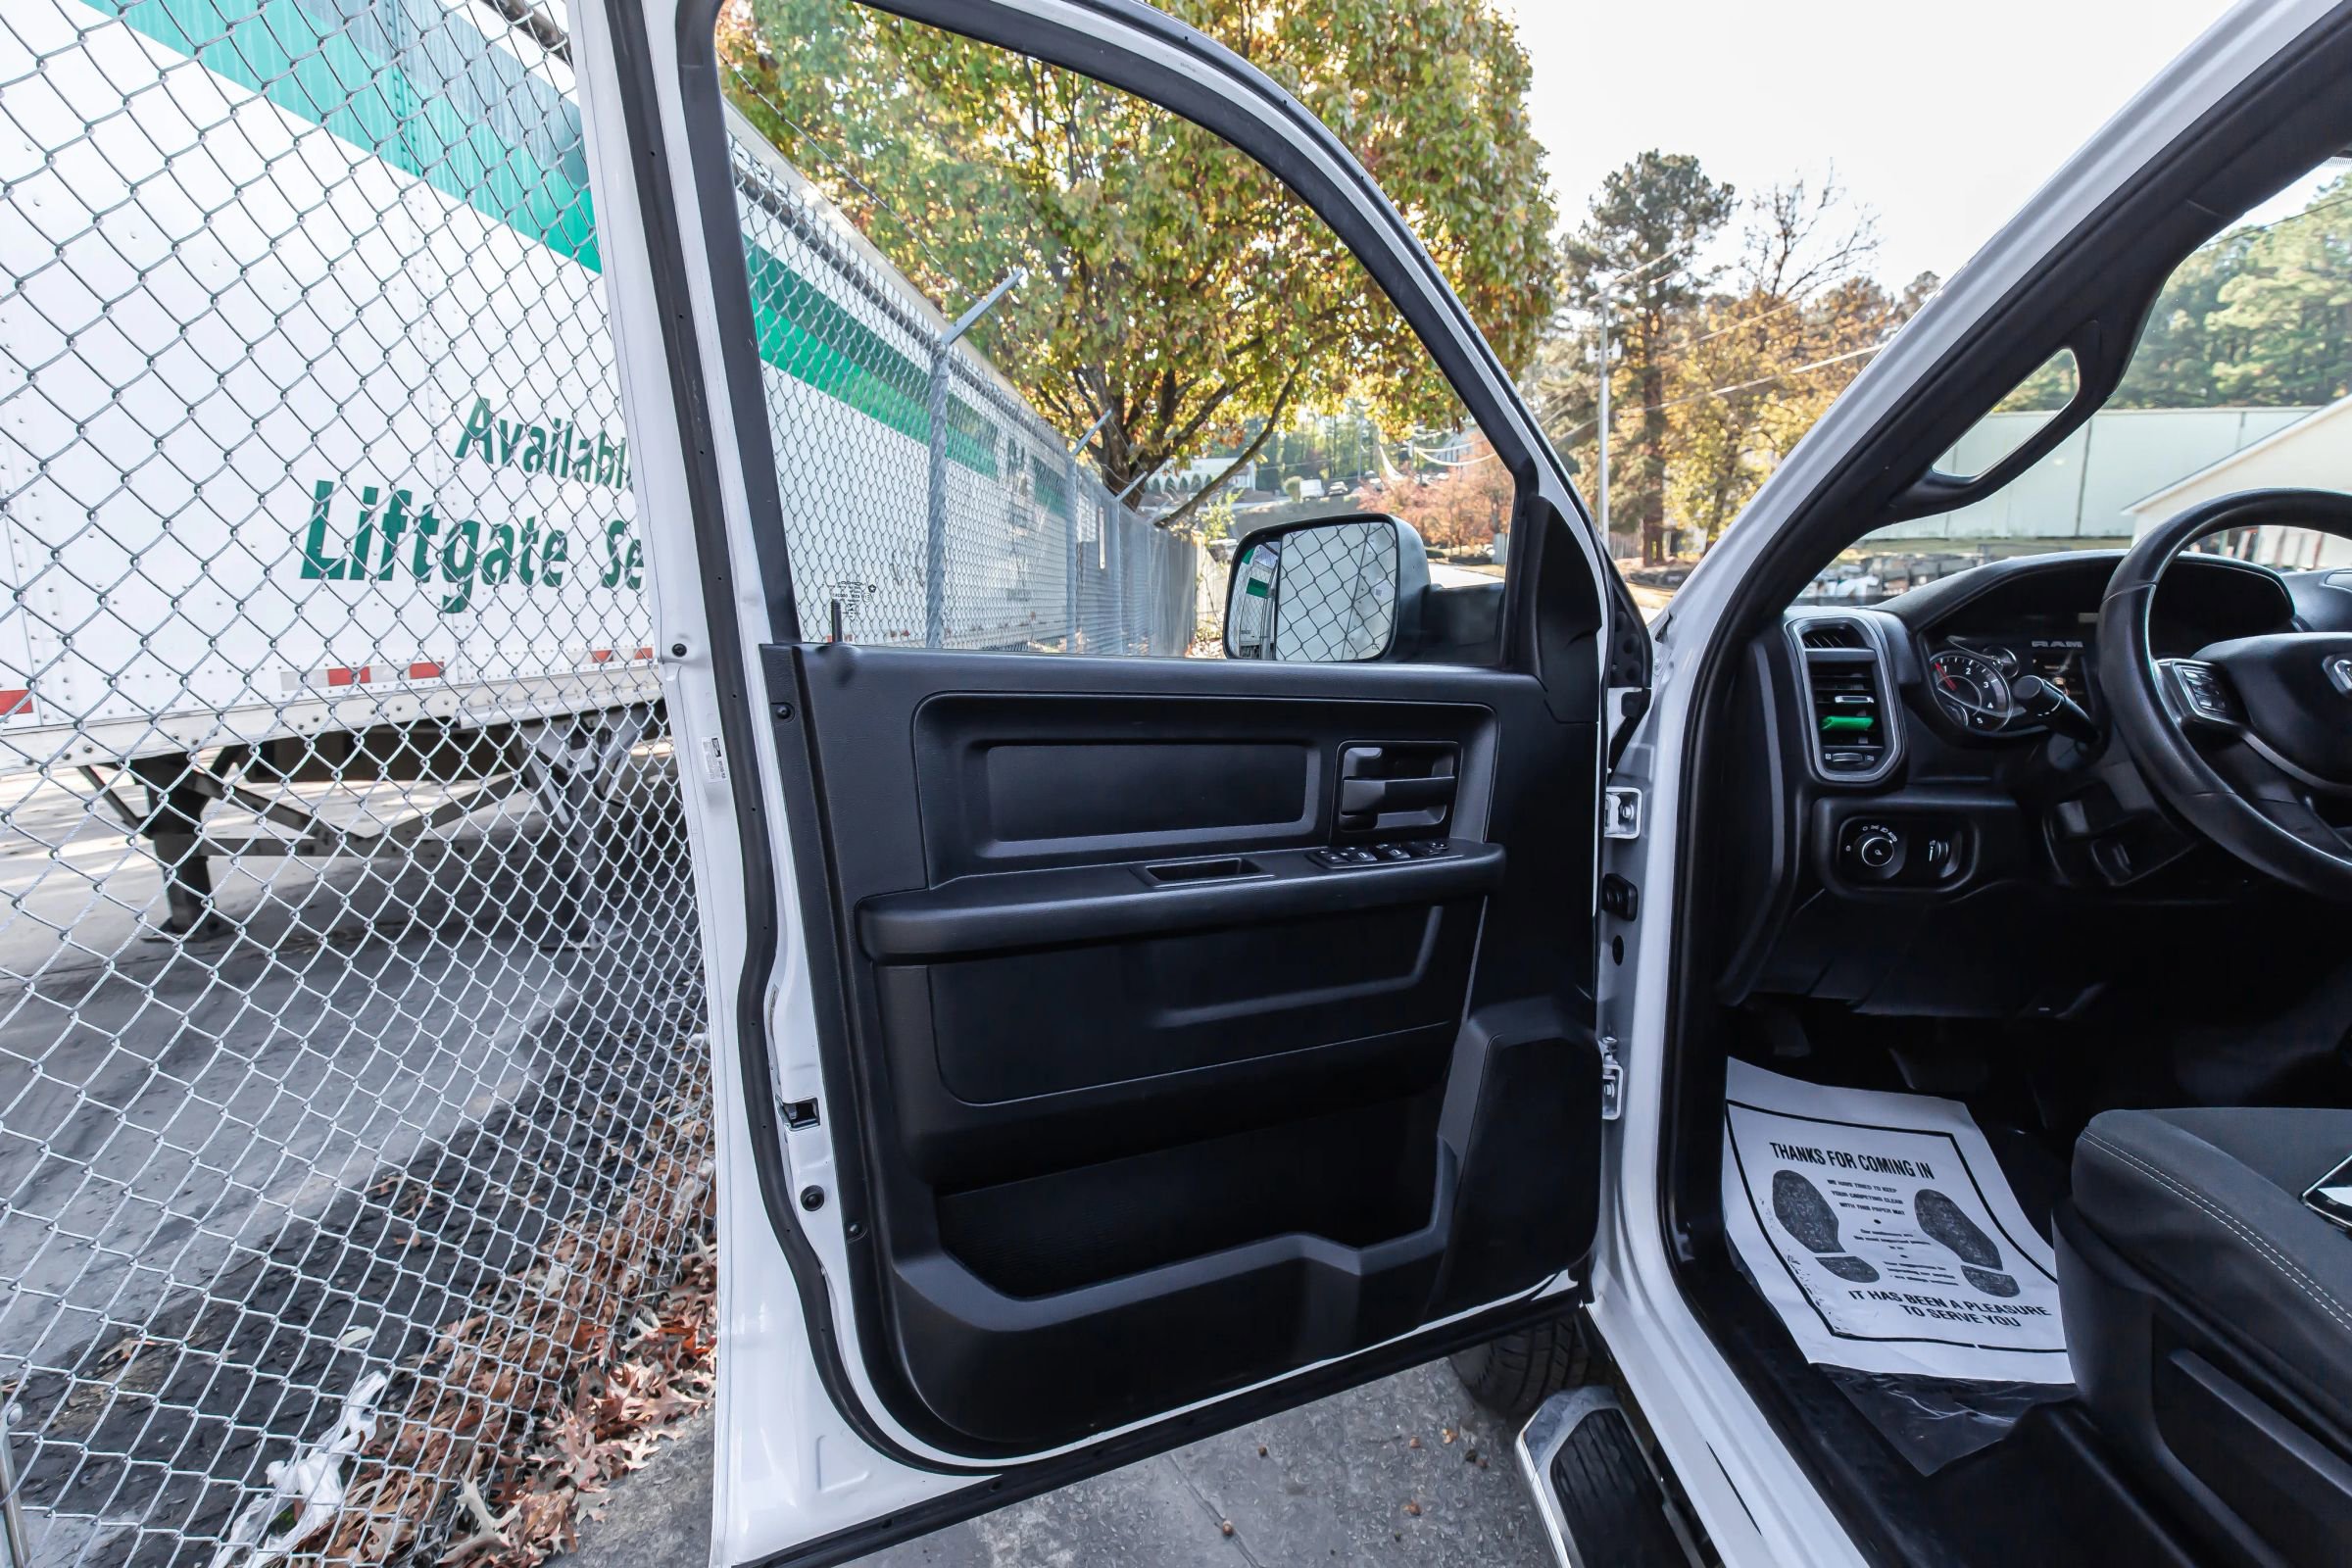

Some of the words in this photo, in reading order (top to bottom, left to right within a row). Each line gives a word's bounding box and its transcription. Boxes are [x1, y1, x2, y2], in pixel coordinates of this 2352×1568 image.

[454, 396, 634, 494] Availabl
[300, 479, 568, 613] Liftgate
[1769, 1142, 1826, 1165] THANKS
[1826, 1150, 1857, 1169] FOR
[1858, 1154, 1915, 1177] COMING
[1915, 1161, 1936, 1180] IN
[1848, 1290, 1865, 1300] IT
[1867, 1290, 1903, 1302] HAS
[1903, 1294, 1949, 1308] BEEN
[1949, 1299, 1961, 1309] A
[1962, 1300, 2052, 1316] PLEASURE
[1899, 1304, 1926, 1317] TO
[1927, 1308, 1984, 1324] SERVE
[1982, 1314, 2022, 1327] YOU
